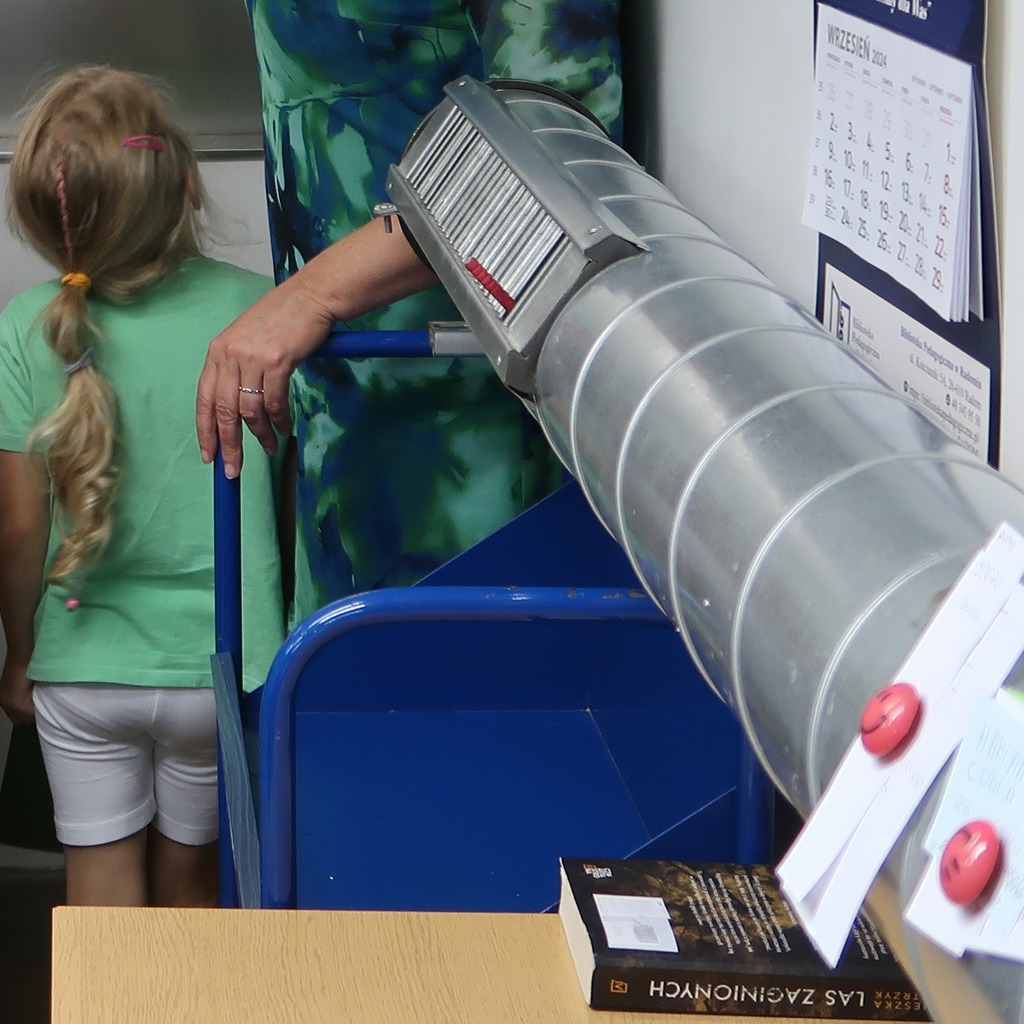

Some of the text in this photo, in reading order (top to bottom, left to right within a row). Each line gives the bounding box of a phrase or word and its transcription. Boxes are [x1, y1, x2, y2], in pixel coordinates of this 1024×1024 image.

[827, 24, 870, 61] WRZESIEŃ
[872, 49, 888, 68] 2024
[649, 980, 865, 1007] LAS ZAGINIONYCH
